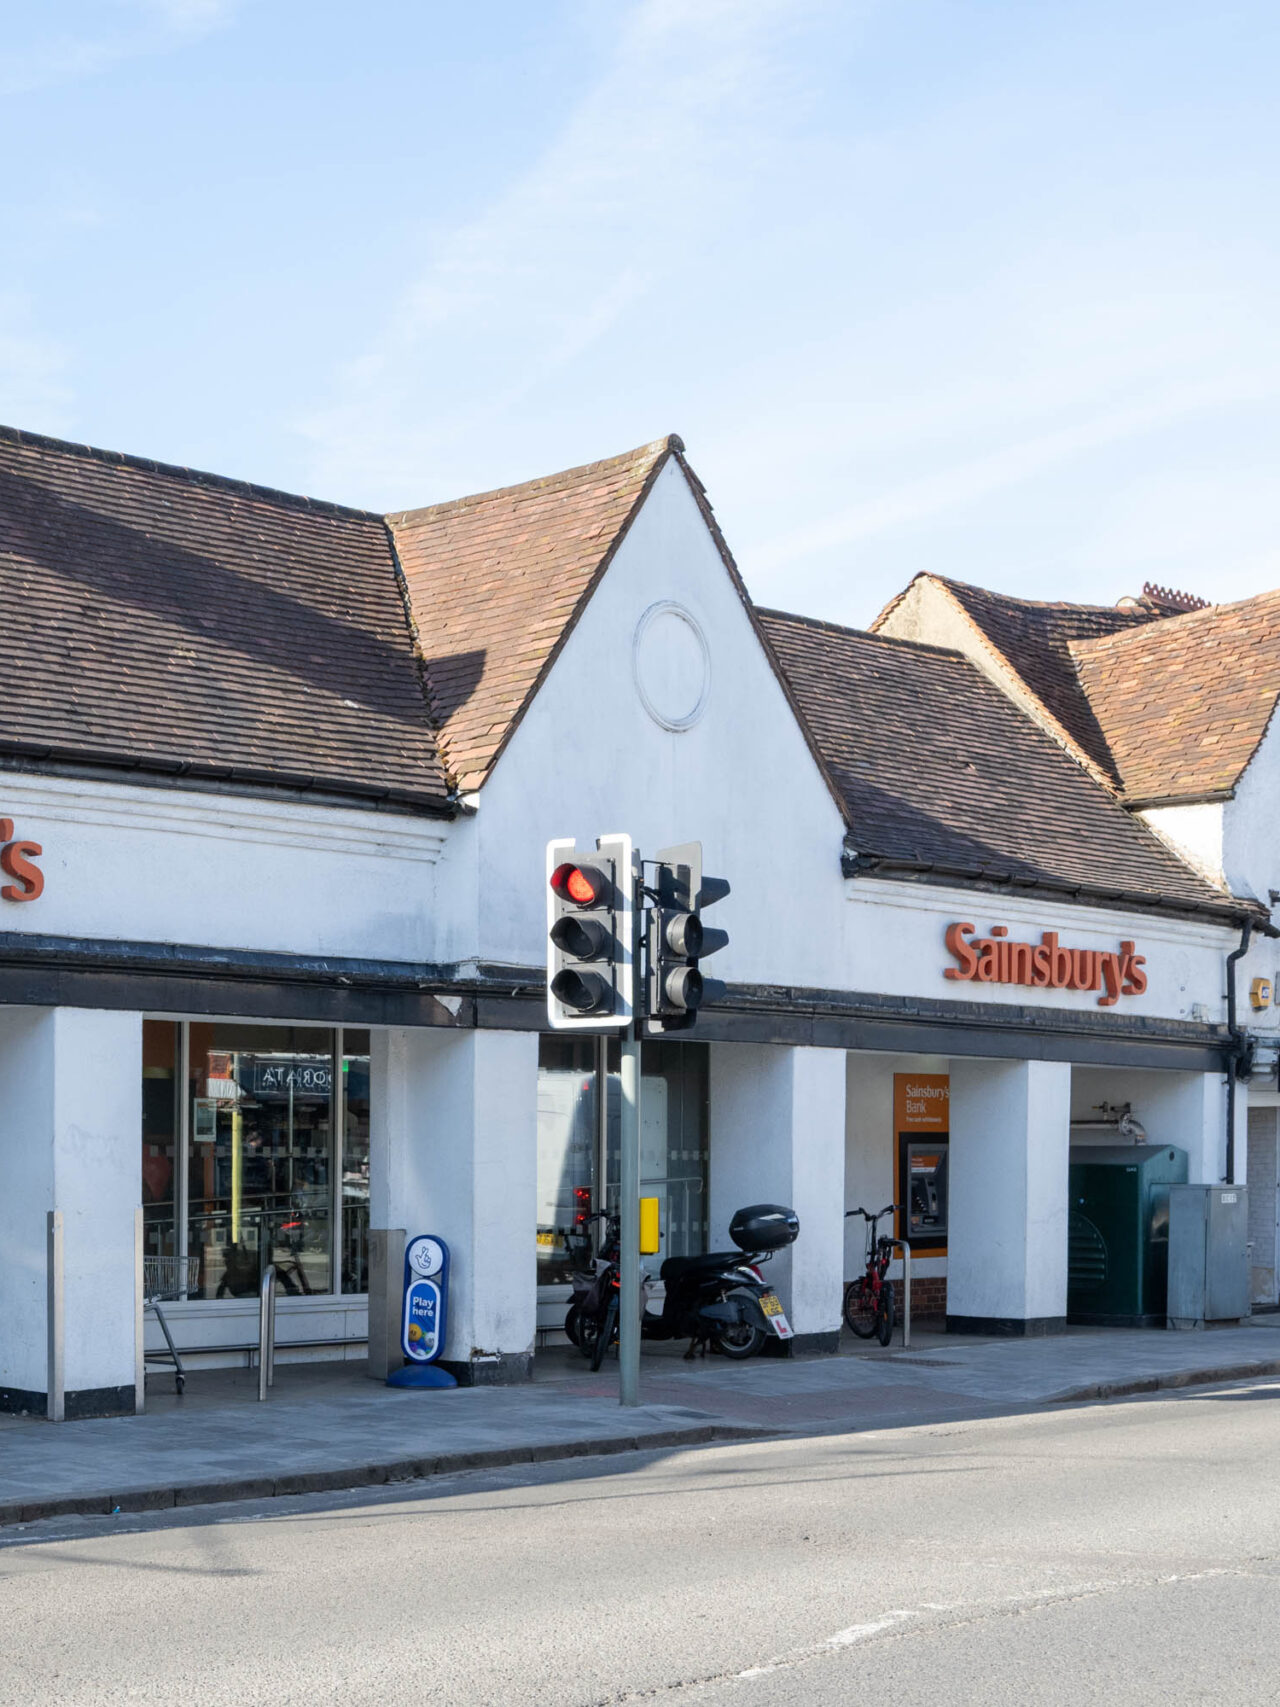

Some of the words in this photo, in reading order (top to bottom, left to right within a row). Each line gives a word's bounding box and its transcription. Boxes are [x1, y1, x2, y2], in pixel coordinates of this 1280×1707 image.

[944, 922, 1148, 1006] Sainsbury's
[905, 1083, 949, 1100] Sainsbury's
[906, 1099, 927, 1113] Bank
[412, 1296, 434, 1309] Play
[412, 1307, 434, 1317] here
[775, 1319, 788, 1333] L
